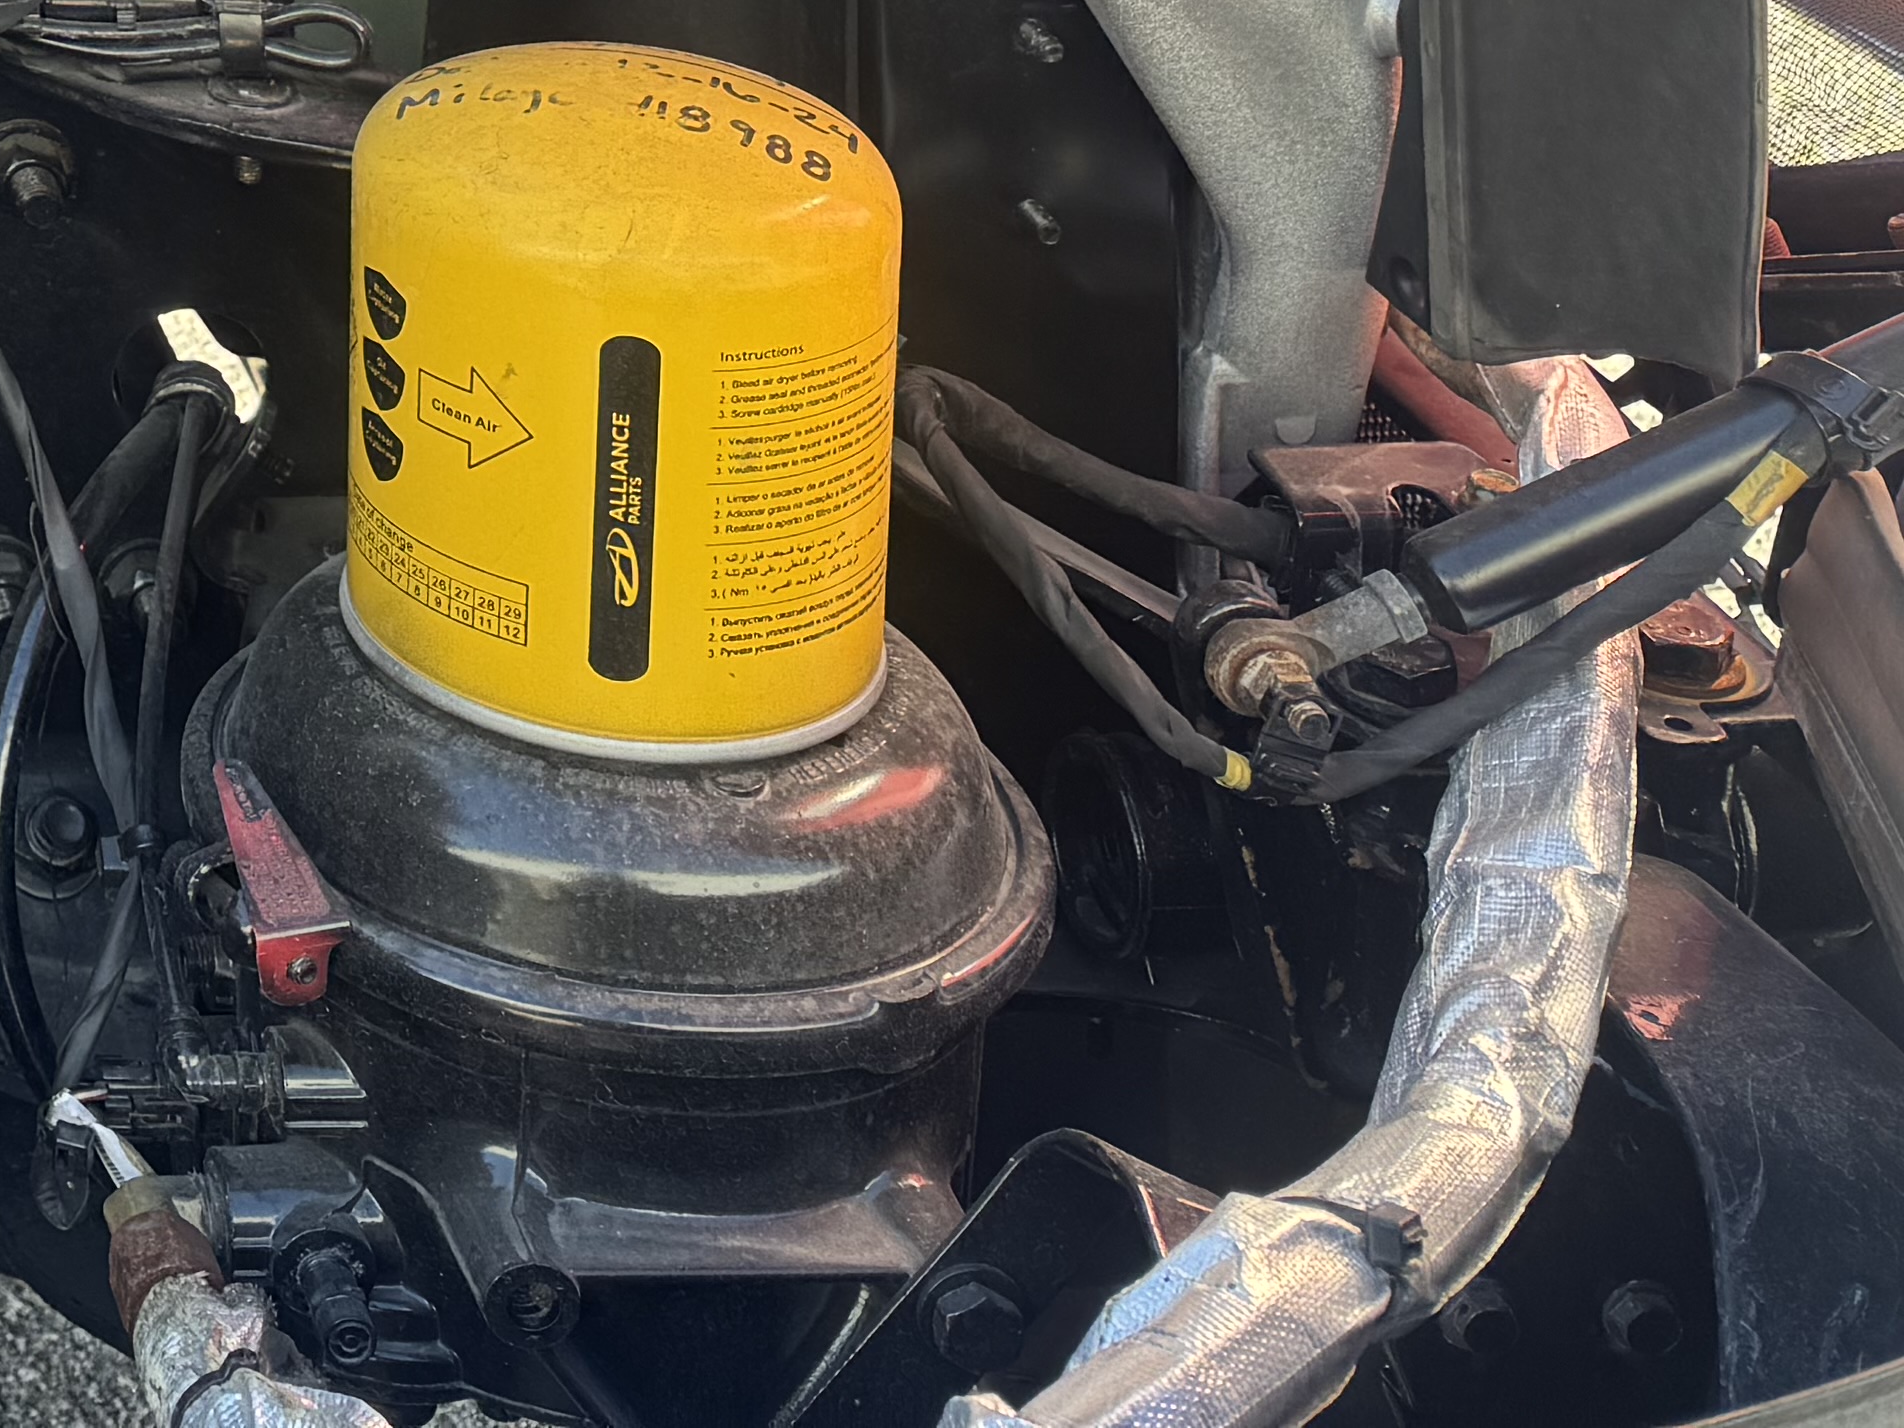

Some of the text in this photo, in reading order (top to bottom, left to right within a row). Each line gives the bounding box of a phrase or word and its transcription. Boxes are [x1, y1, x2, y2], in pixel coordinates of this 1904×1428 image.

[720, 343, 804, 362] Instructions
[731, 392, 766, 403] Grease
[732, 378, 760, 389] Bleed
[776, 372, 799, 385] dryer
[431, 397, 502, 433] Clean Air
[731, 408, 760, 418] Screw
[610, 411, 631, 526] ALLIANCE
[627, 476, 642, 526] PARTS
[375, 516, 415, 552] change
[394, 553, 408, 569] 24
[412, 564, 425, 580] 25
[432, 575, 446, 591] 26
[454, 587, 470, 601] 27
[478, 596, 494, 611] 28
[504, 605, 522, 619] 29
[397, 573, 402, 583] 7
[435, 597, 442, 609] 9
[455, 606, 470, 621] 10
[479, 615, 492, 629] 11
[504, 624, 521, 638] 12
